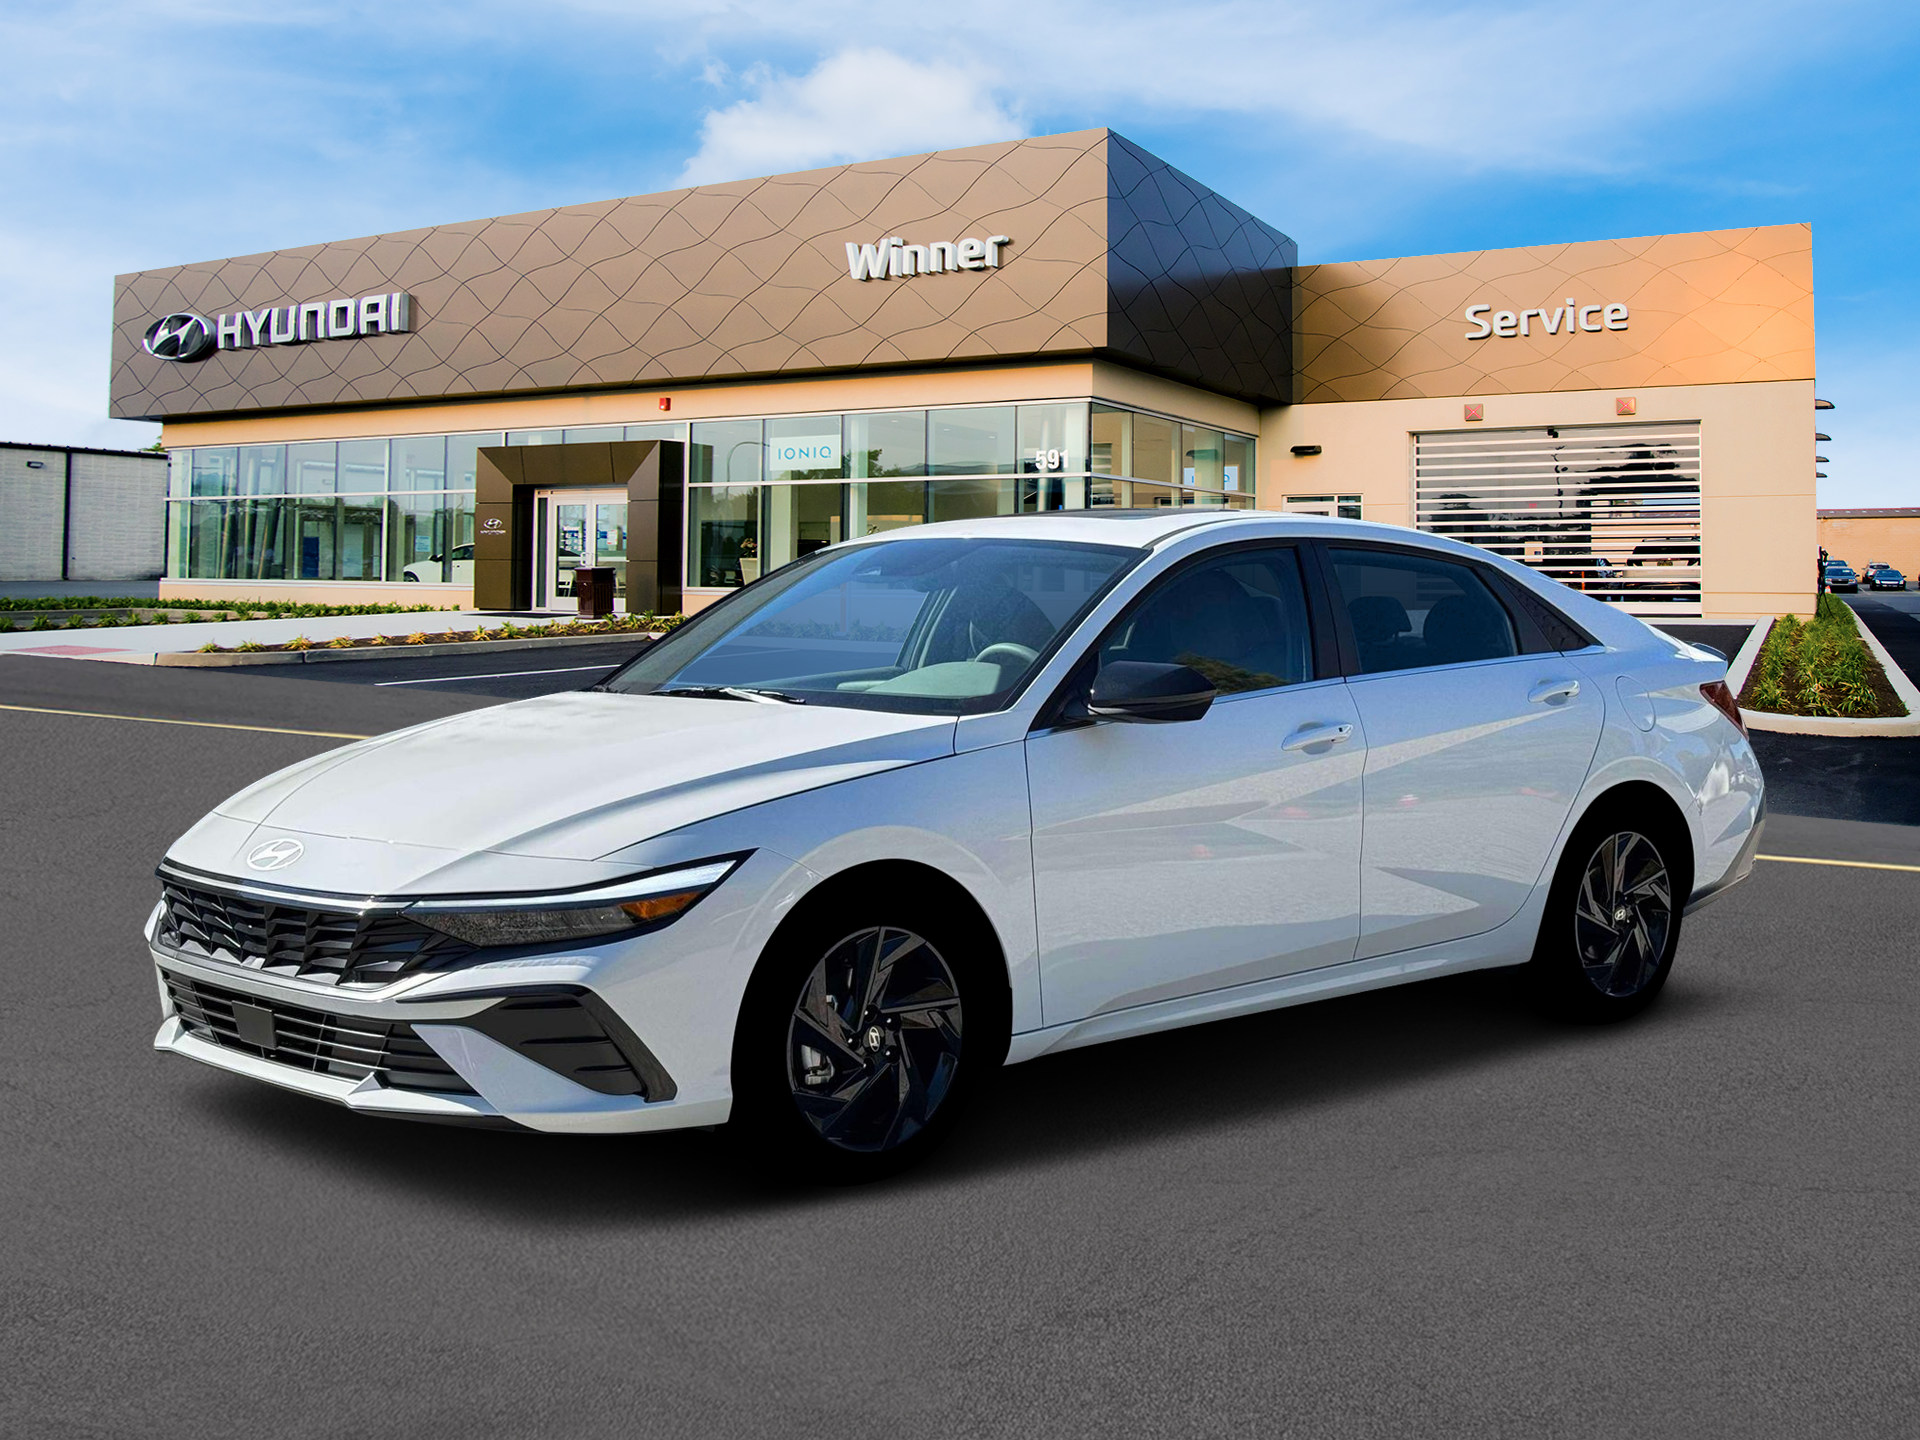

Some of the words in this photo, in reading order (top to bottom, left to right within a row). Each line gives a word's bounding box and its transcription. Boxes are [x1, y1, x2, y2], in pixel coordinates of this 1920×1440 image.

[845, 235, 1009, 281] Winner
[216, 292, 408, 350] HYUNDAI
[1464, 297, 1629, 340] Service
[778, 446, 832, 460] IONIQ
[1035, 449, 1069, 470] 591
